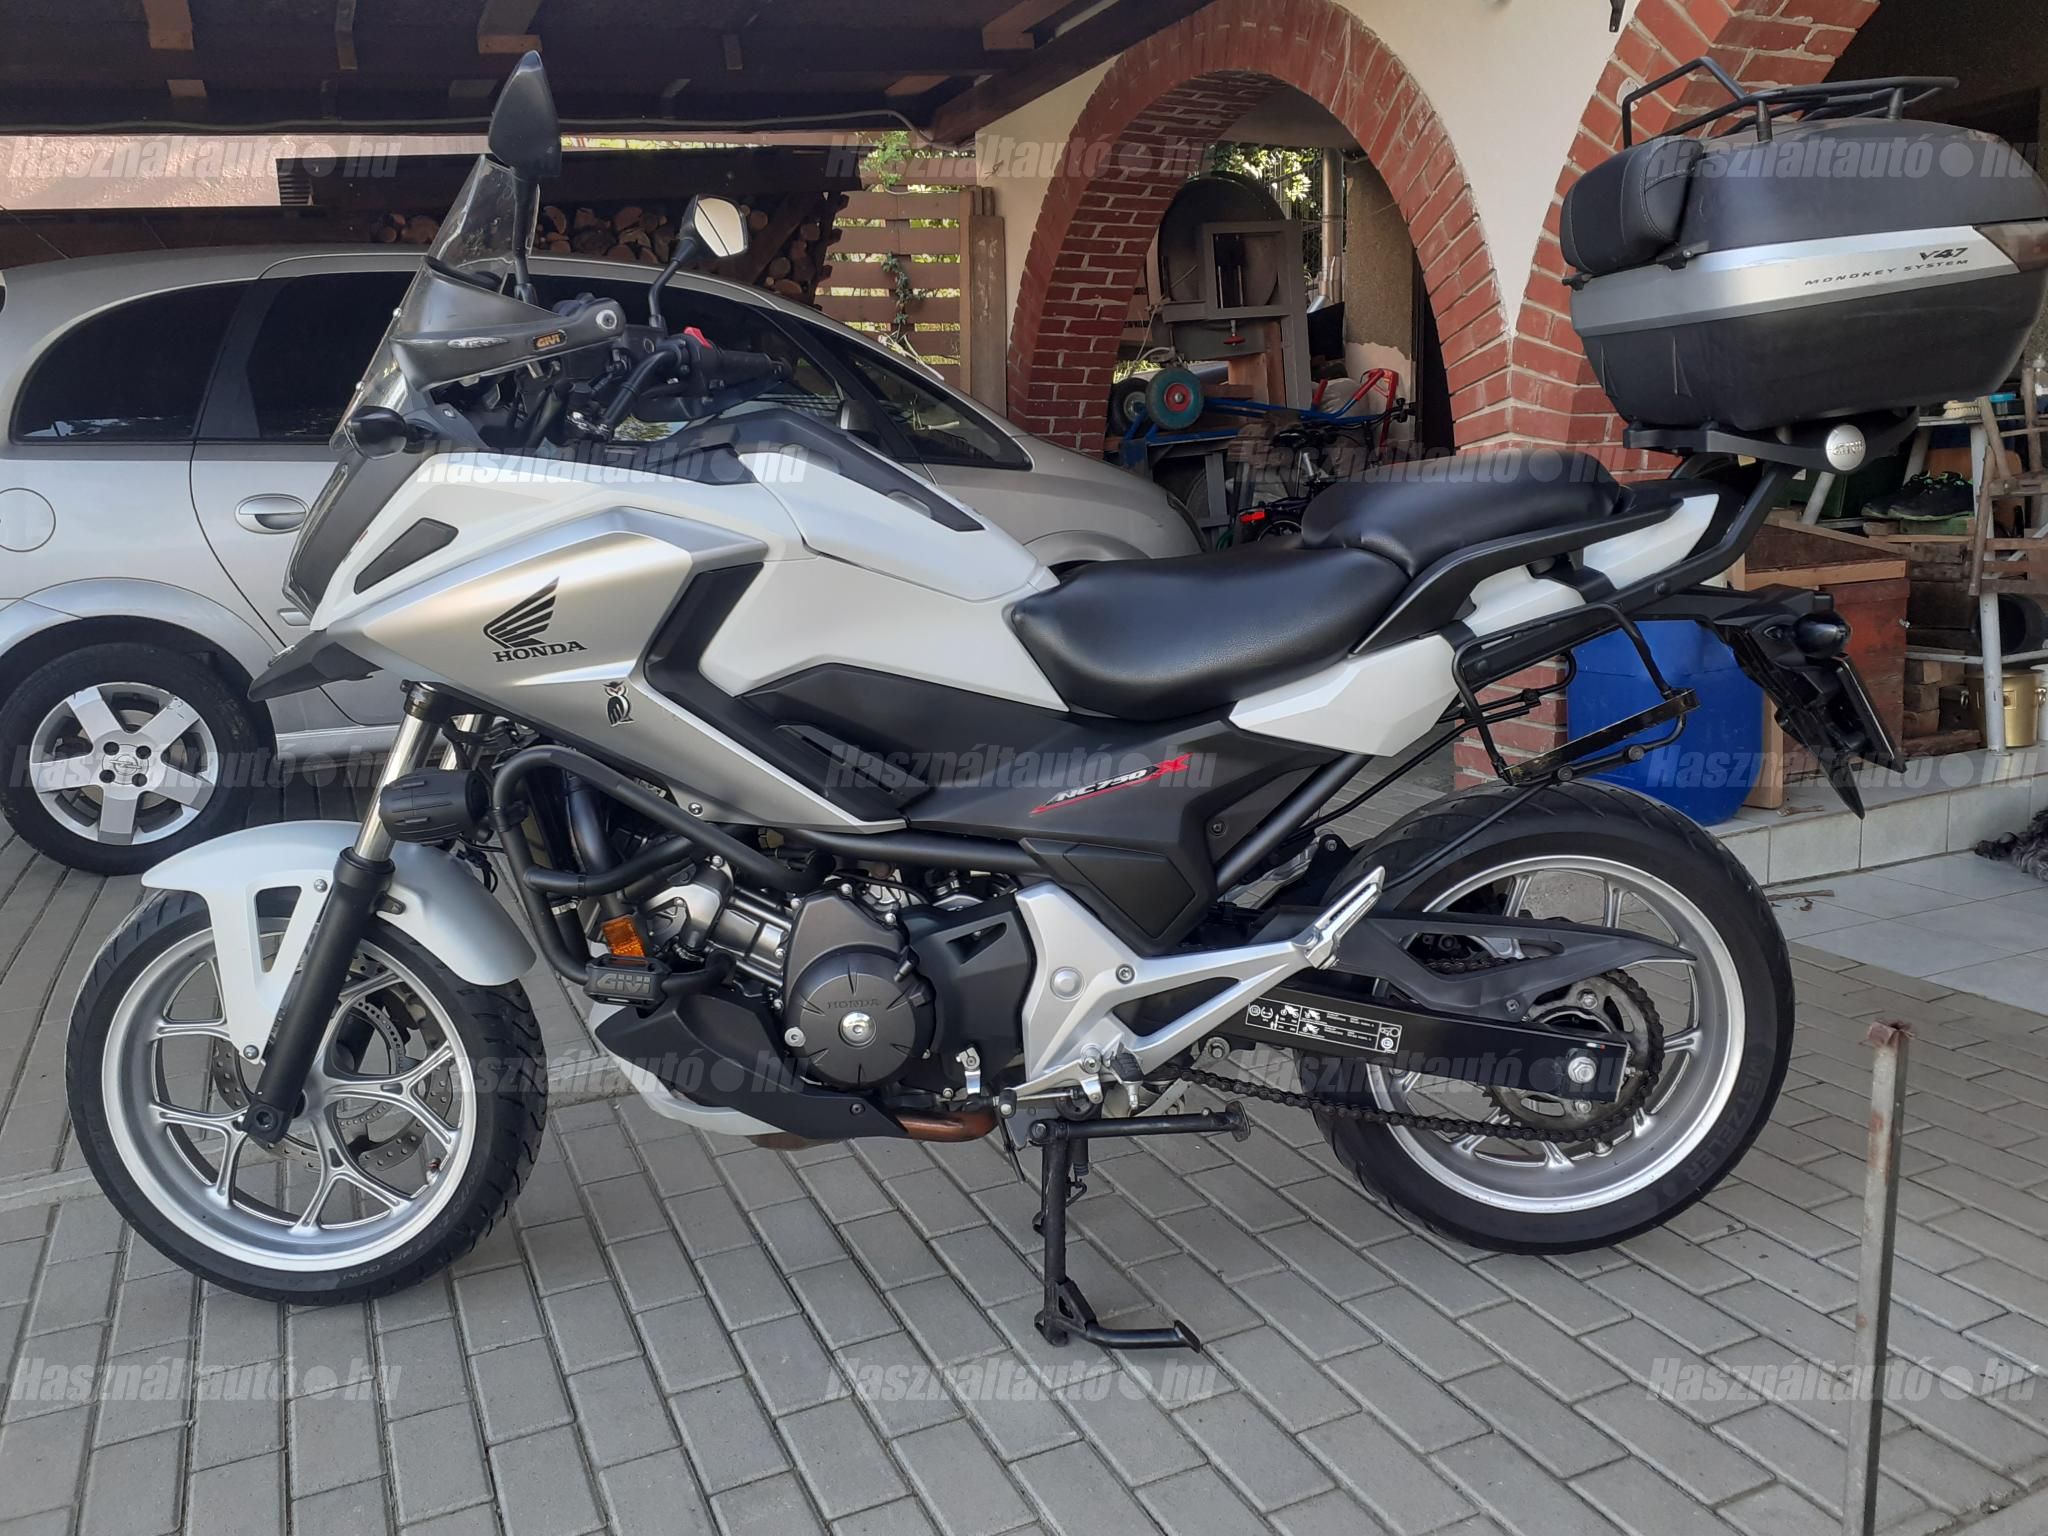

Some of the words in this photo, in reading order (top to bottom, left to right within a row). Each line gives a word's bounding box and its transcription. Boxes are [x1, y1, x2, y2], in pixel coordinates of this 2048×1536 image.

[1919, 247, 1969, 261] V47
[1804, 267, 1897, 286] MONOKEY
[1903, 259, 1969, 272] SYSTEM
[536, 334, 561, 348] GIVI
[492, 640, 588, 663] HONDA
[596, 973, 651, 994] GIVI
[827, 998, 881, 1009] HONDA
[1686, 1055, 1768, 1181] METZELER
